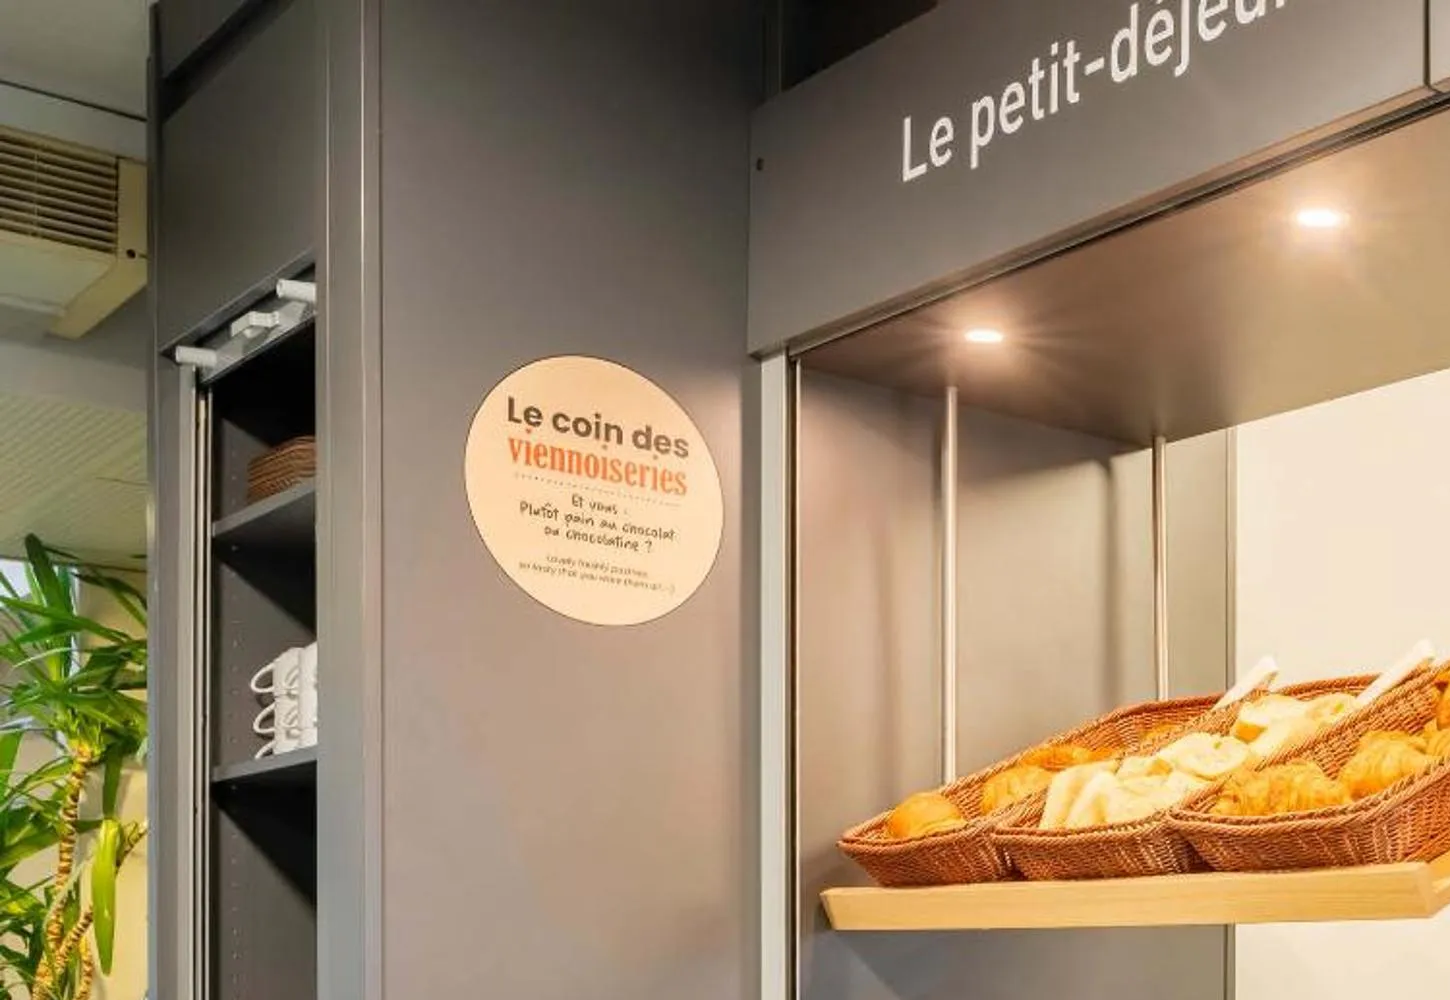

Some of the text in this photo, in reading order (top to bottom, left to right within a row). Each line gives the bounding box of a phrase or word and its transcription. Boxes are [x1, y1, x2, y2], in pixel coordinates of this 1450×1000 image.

[902, 0, 1286, 182] Le petit-déje
[507, 396, 690, 460] Le coin des
[507, 428, 688, 497] viennoiseries
[519, 500, 676, 542] Plutôt pain au chocolat
[571, 493, 584, 509] Et
[544, 526, 653, 554] ou chocolatine ?
